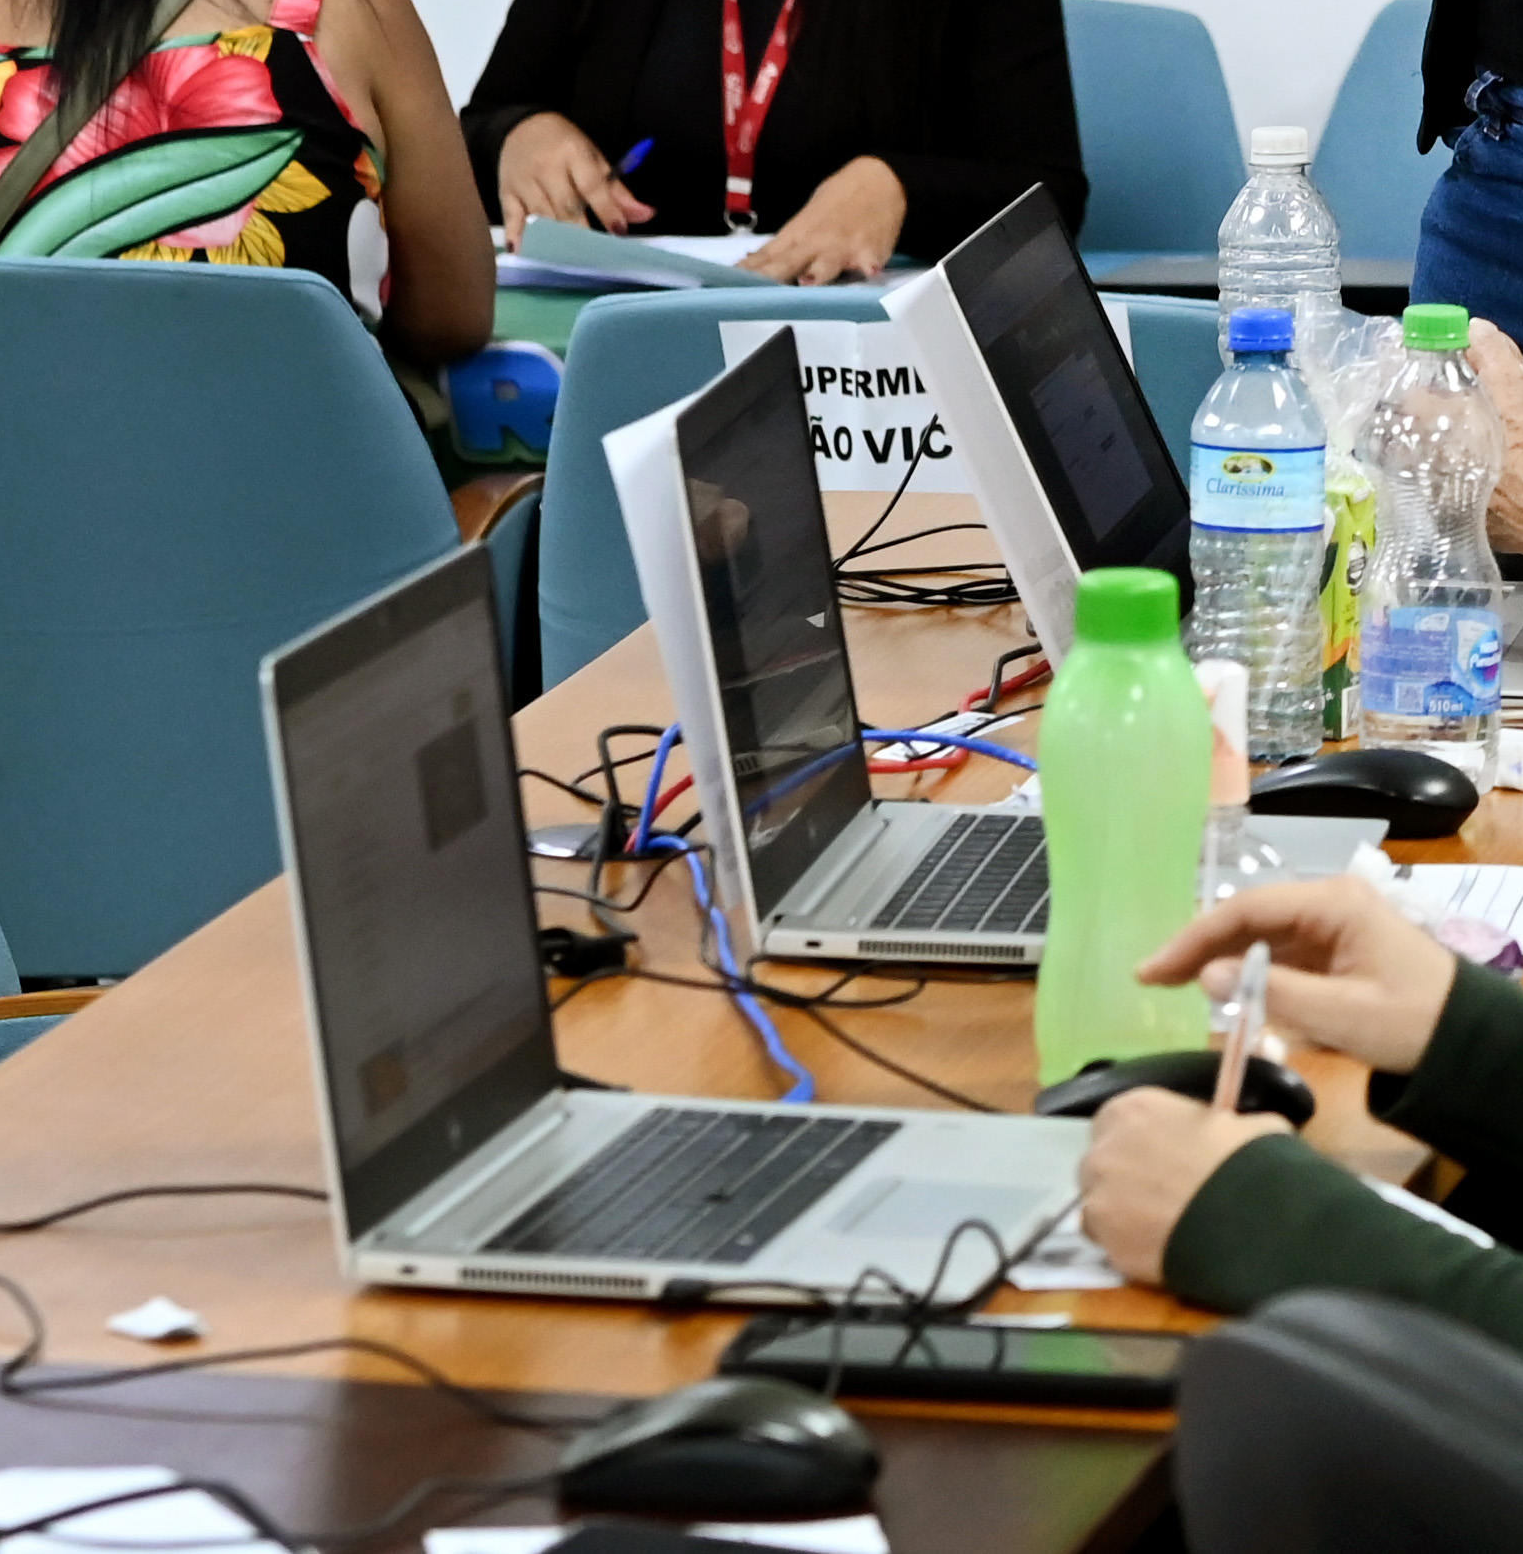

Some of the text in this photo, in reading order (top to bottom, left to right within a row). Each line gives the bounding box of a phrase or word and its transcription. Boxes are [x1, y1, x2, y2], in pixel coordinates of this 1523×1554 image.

[800, 365, 928, 398] UPERM
[810, 415, 953, 464] ÃO VIC
